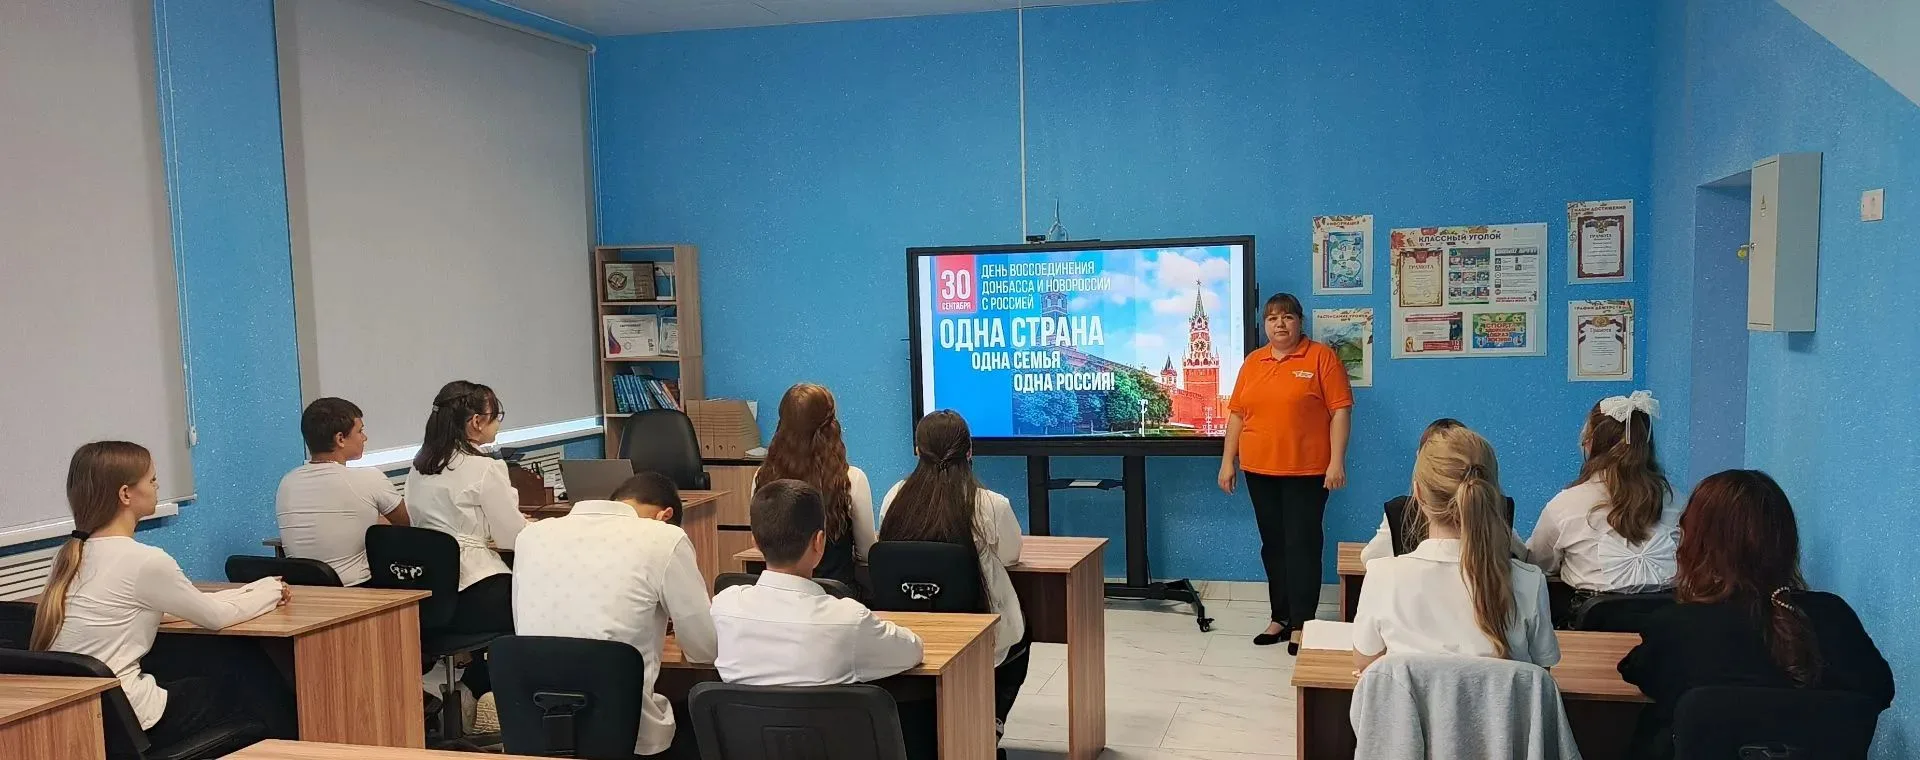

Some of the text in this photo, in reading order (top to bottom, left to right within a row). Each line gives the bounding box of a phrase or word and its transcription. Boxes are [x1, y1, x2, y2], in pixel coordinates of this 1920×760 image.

[1418, 232, 1502, 243] КЛАССНЫЙ УГОЛОК
[981, 261, 1095, 279] ДЕНЬ ВОССОЕДИНЕНИЯ
[941, 269, 971, 300] 30
[981, 277, 1112, 295] ДОНБАССА И НОВОРОССИИ
[941, 302, 971, 311] СЕНТЯБРЯ
[981, 294, 1034, 311] С РОССИЕЙ
[939, 315, 1104, 352] ОДНА СТРАНА
[972, 350, 1061, 371] ОДНА СЕМЬЯ
[1014, 371, 1115, 394] ОДНА РОССИЯ!
